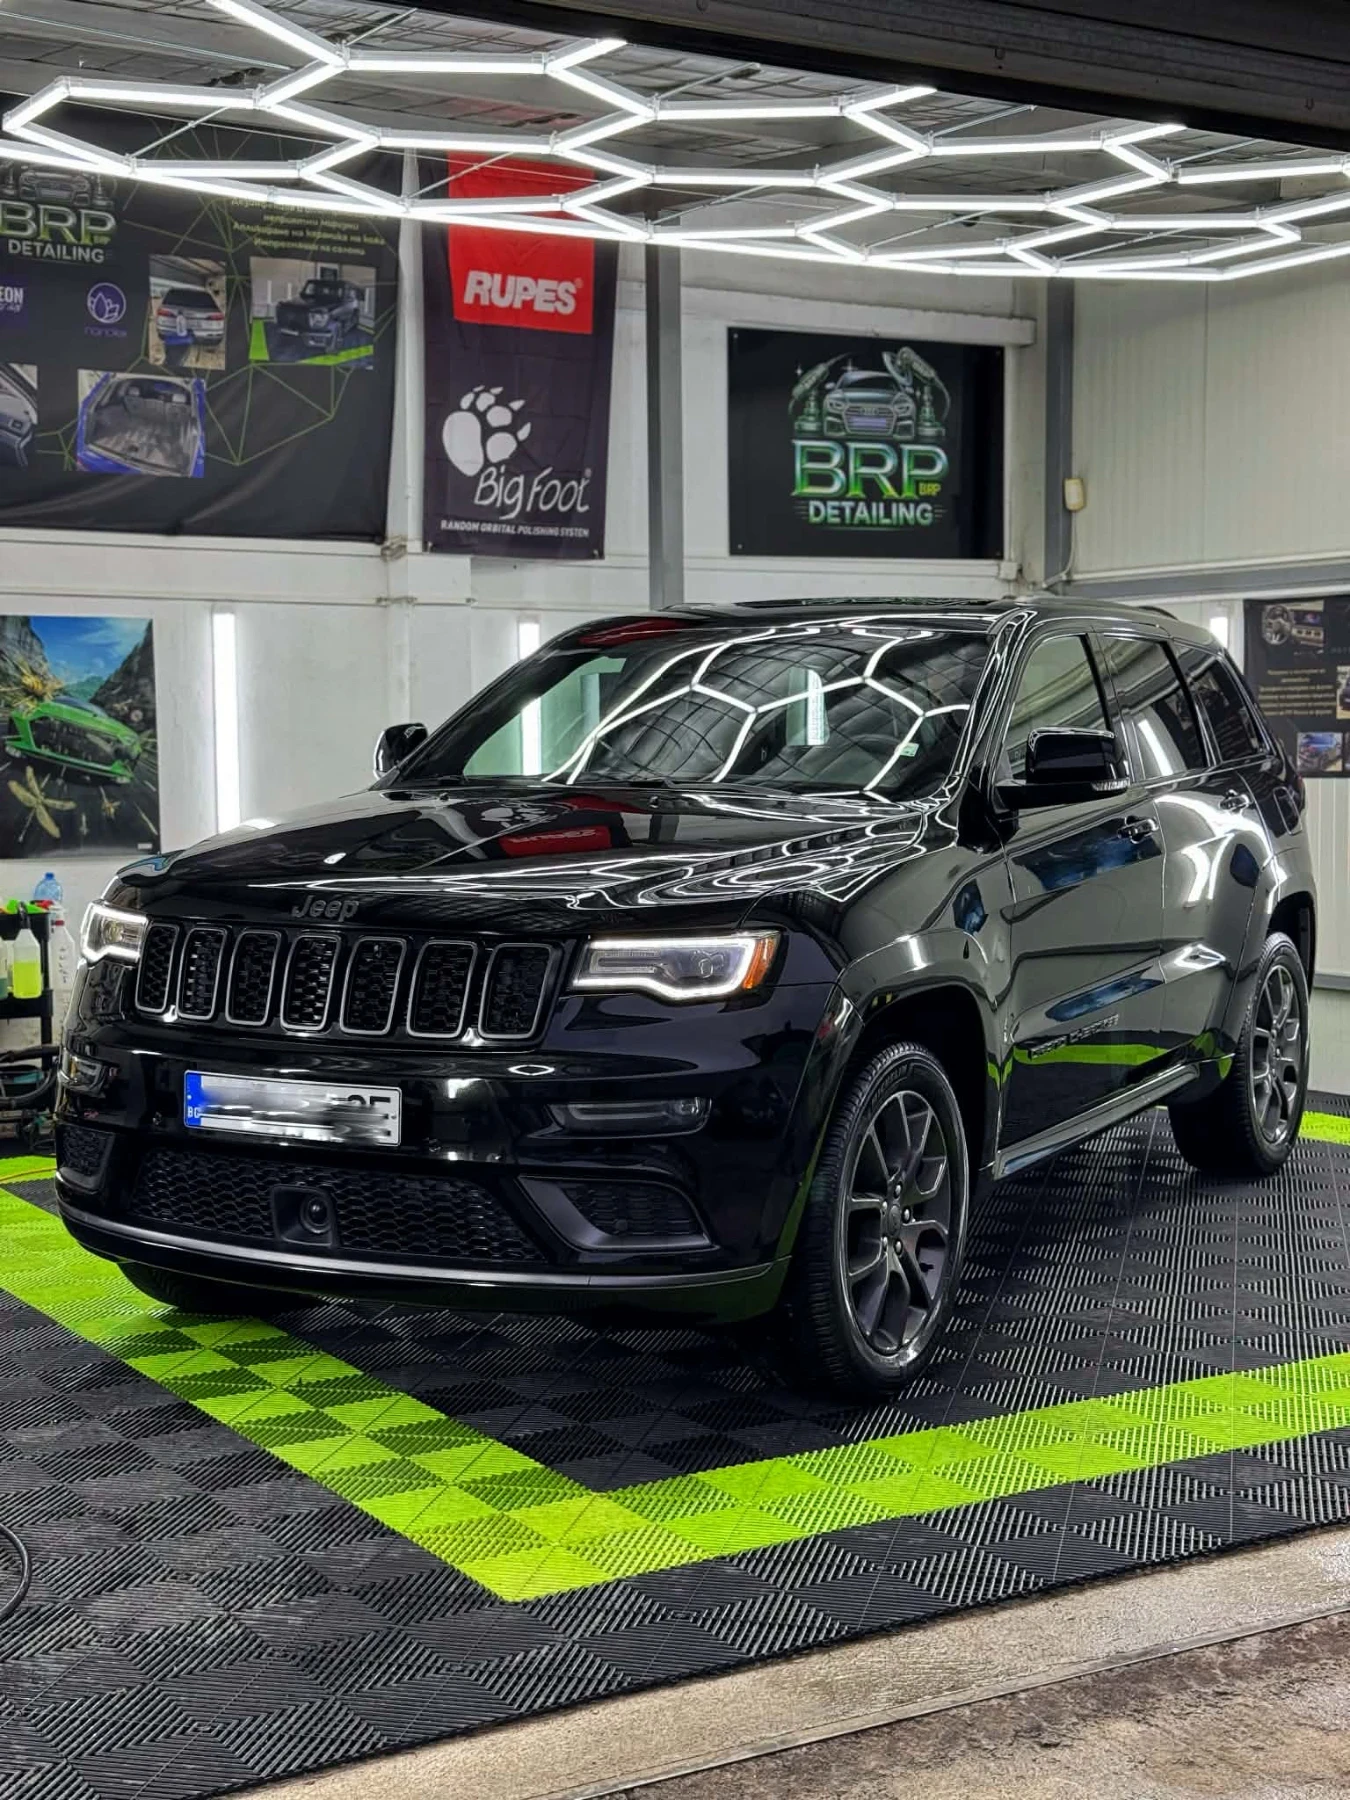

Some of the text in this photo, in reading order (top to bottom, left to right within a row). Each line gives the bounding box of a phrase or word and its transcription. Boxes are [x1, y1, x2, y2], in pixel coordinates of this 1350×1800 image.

[0, 200, 117, 246] BRP
[8, 239, 105, 263] DETAILING
[463, 270, 577, 315] RUPES
[790, 439, 949, 499] BRP
[808, 500, 934, 526] DETAILING
[440, 519, 590, 538] RANDOM ORBITAL POLISHING SYSTEM
[291, 894, 360, 922] Jeep
